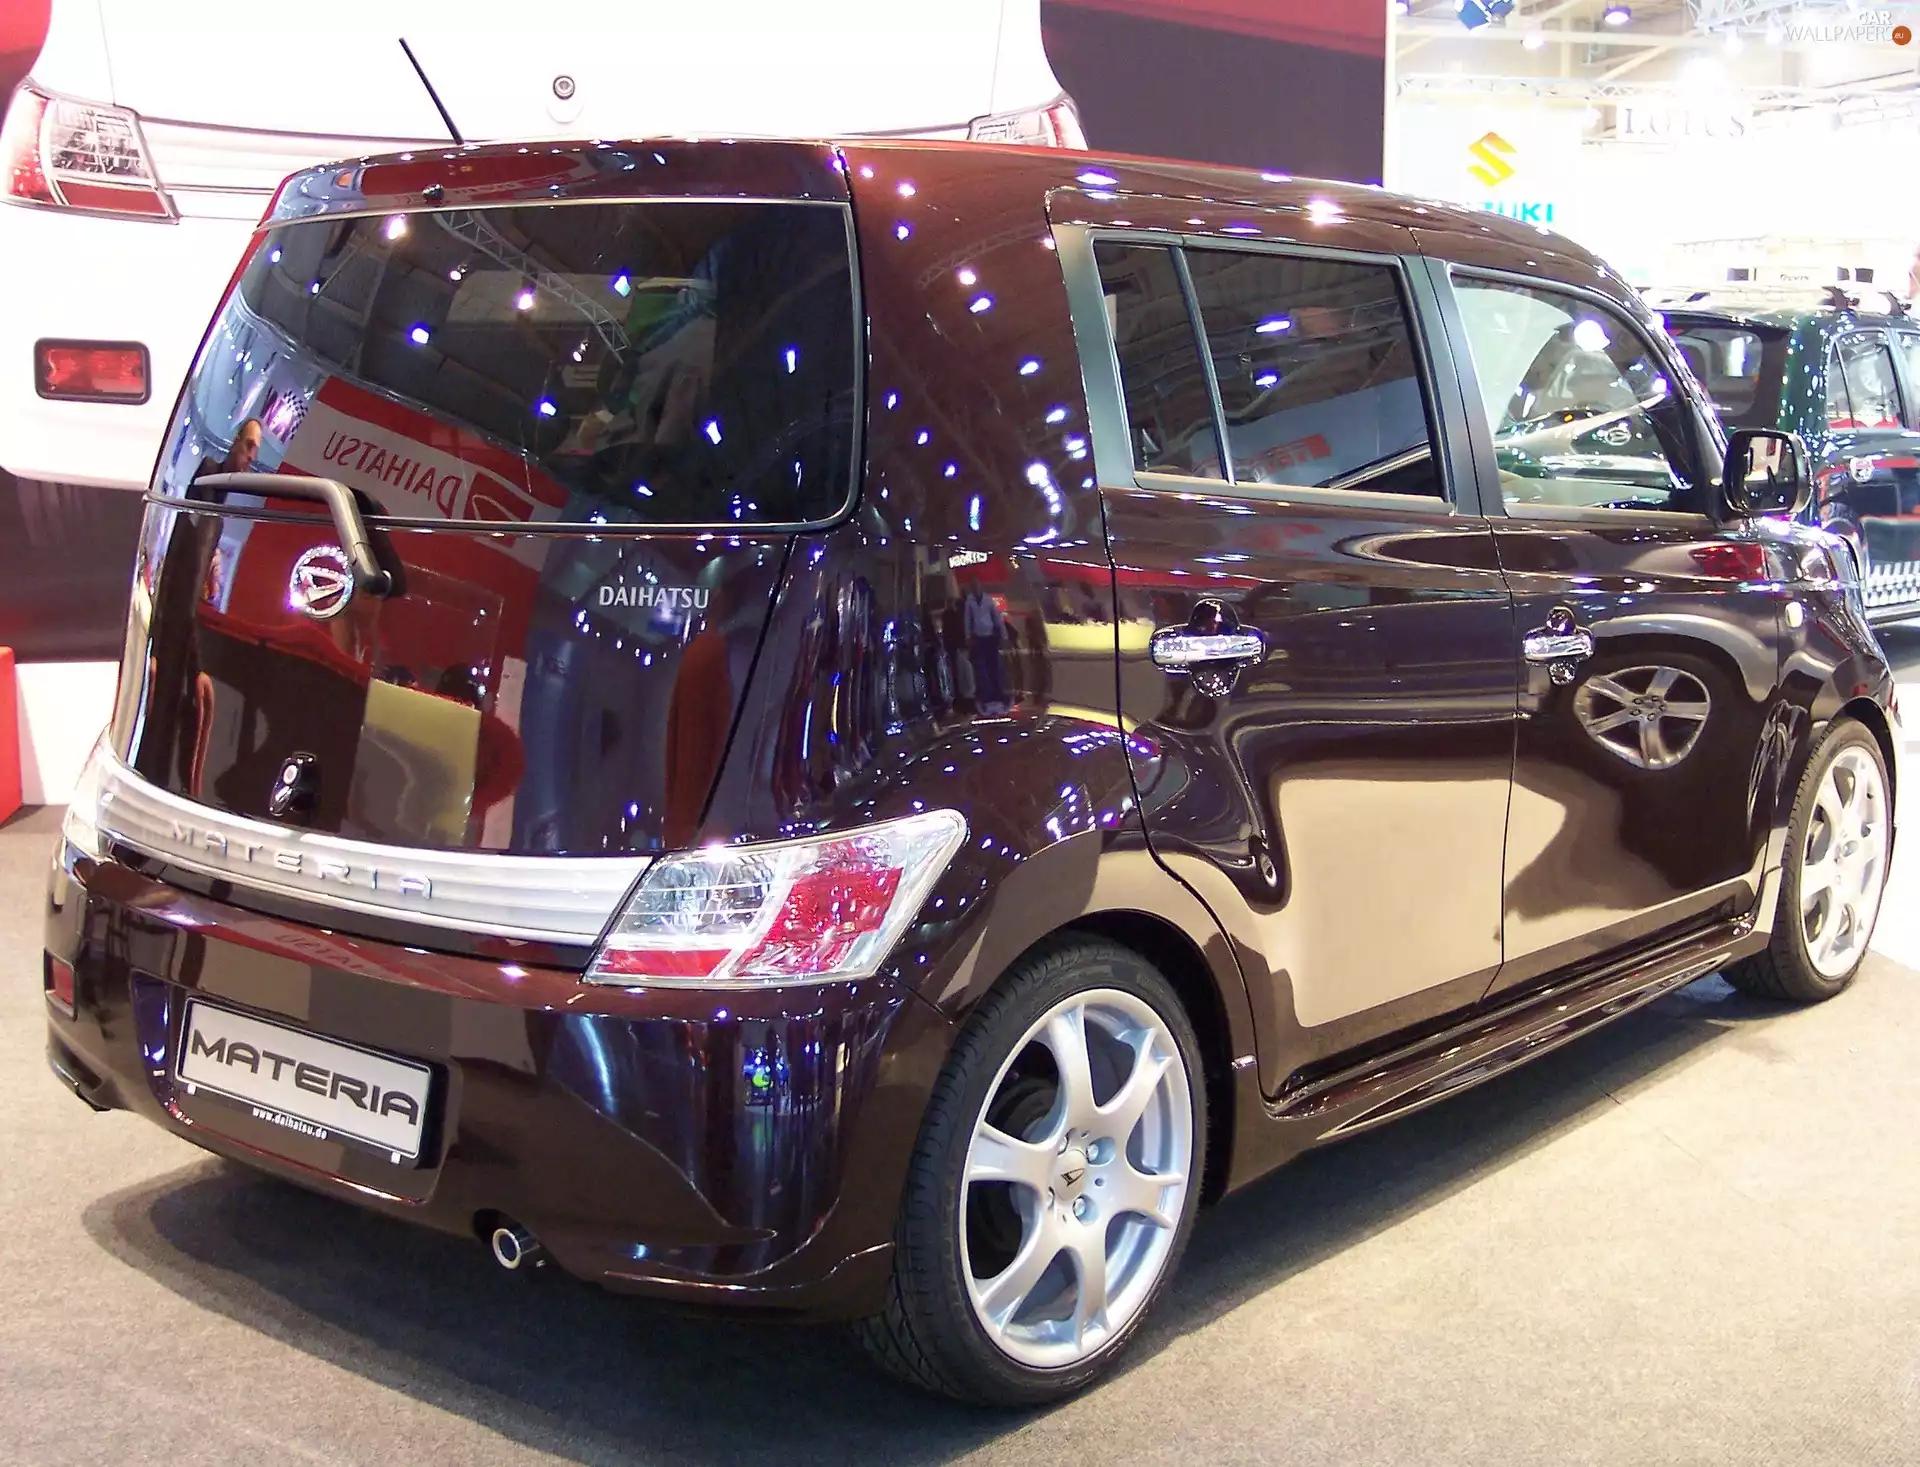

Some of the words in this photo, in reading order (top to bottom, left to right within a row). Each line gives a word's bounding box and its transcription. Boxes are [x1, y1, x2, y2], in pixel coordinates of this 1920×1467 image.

[599, 585, 710, 609] DAIHATSU
[172, 818, 433, 900] MATERIA
[190, 1028, 420, 1127] MATERIA
[252, 1106, 328, 1140] www.daihatsu.de
